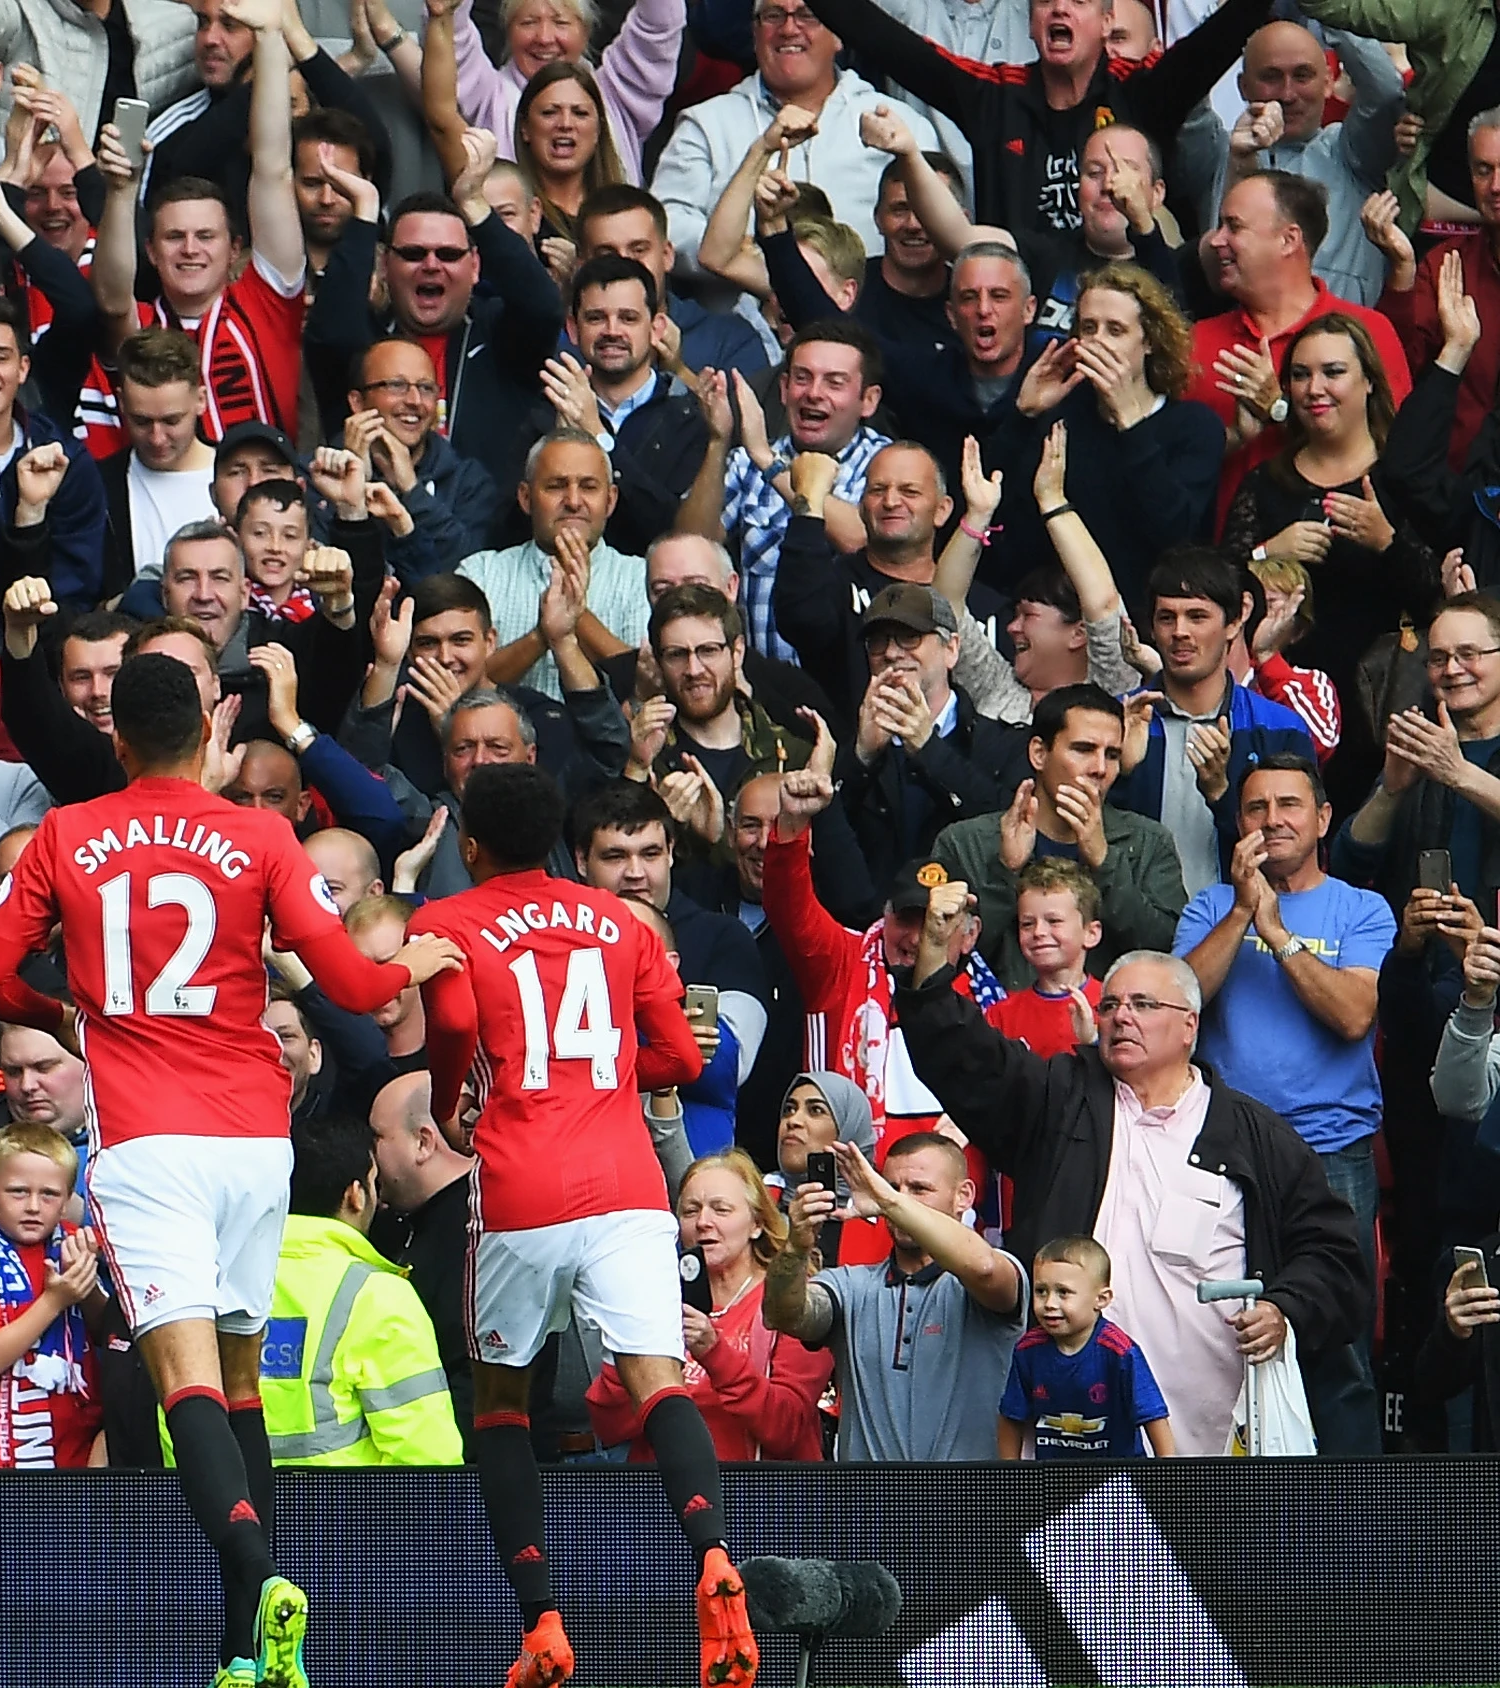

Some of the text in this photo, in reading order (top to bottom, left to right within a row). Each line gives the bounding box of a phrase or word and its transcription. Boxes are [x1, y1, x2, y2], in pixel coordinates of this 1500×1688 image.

[74, 815, 251, 879] SMALLING
[97, 871, 217, 1016] 12
[480, 901, 620, 953] LNGARD
[508, 947, 622, 1090] 14
[1036, 1436, 1110, 1450] CHEVROLET
